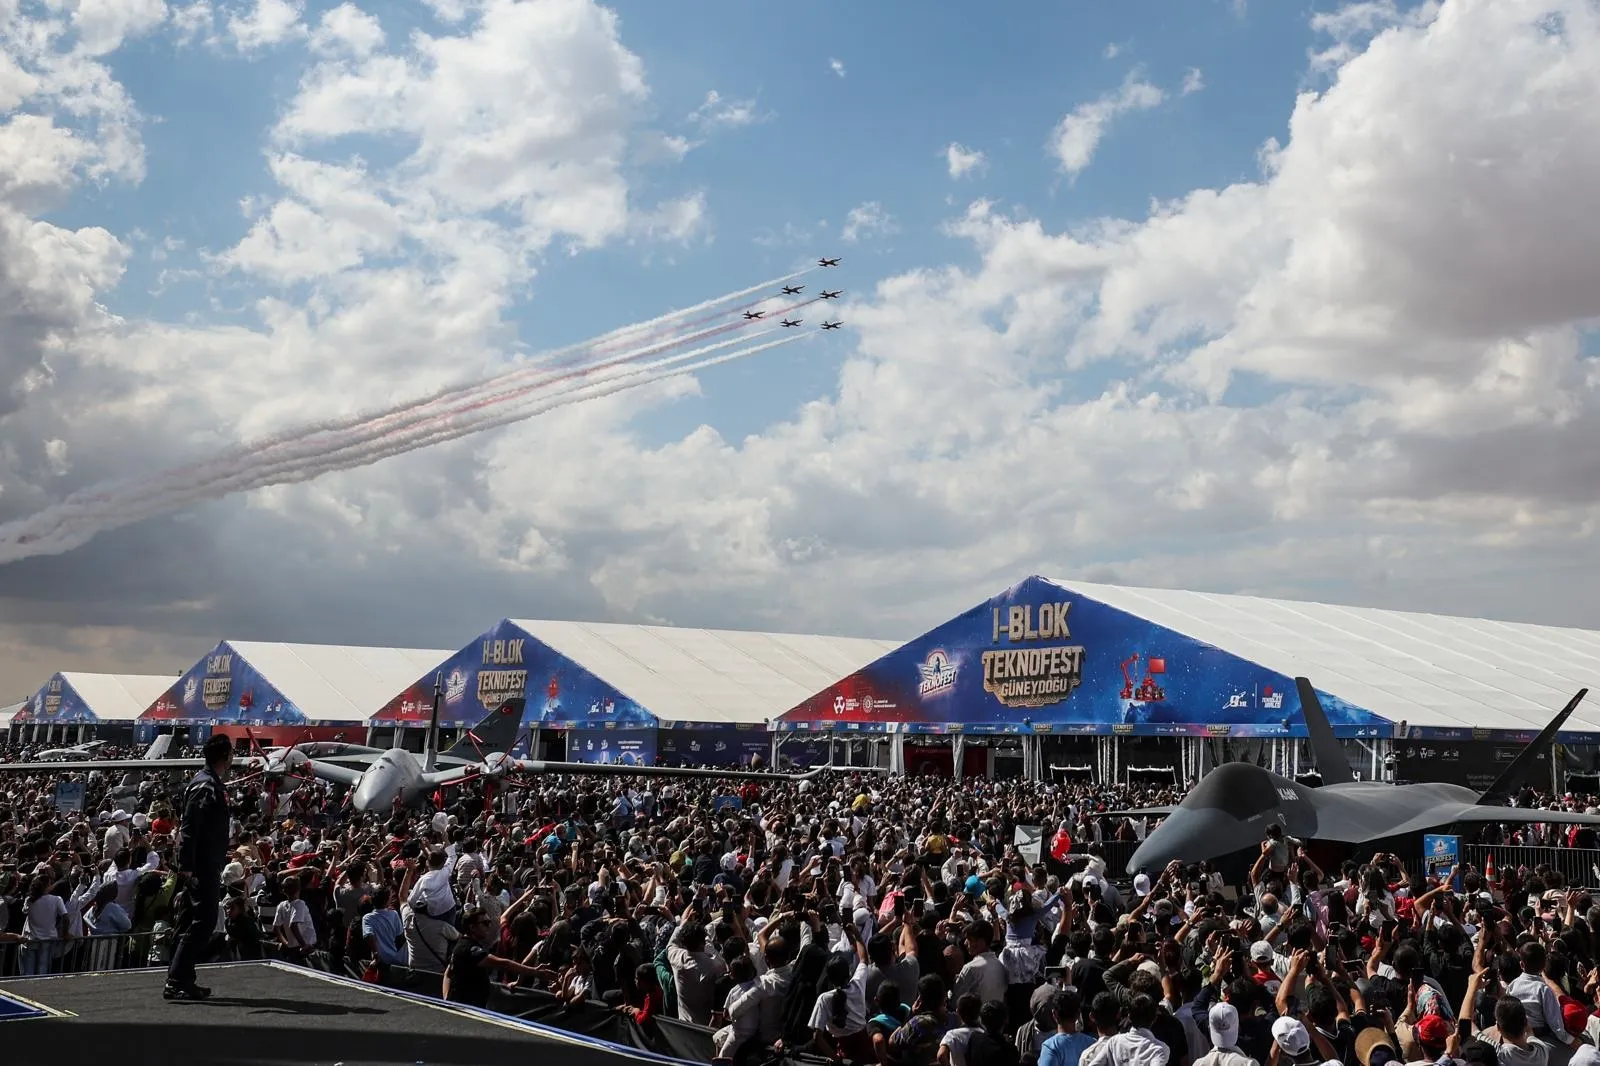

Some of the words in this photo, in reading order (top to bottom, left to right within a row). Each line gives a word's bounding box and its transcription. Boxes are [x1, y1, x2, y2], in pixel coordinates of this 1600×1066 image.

[992, 601, 1071, 643] I-BLOK
[482, 638, 525, 665] H-BLOK
[981, 646, 1086, 680] TEKNOFEST
[478, 670, 528, 691] TEKNOFEST
[919, 669, 957, 695] TEKNOFEST
[1000, 676, 1068, 697] GÜNEYDOĞU
